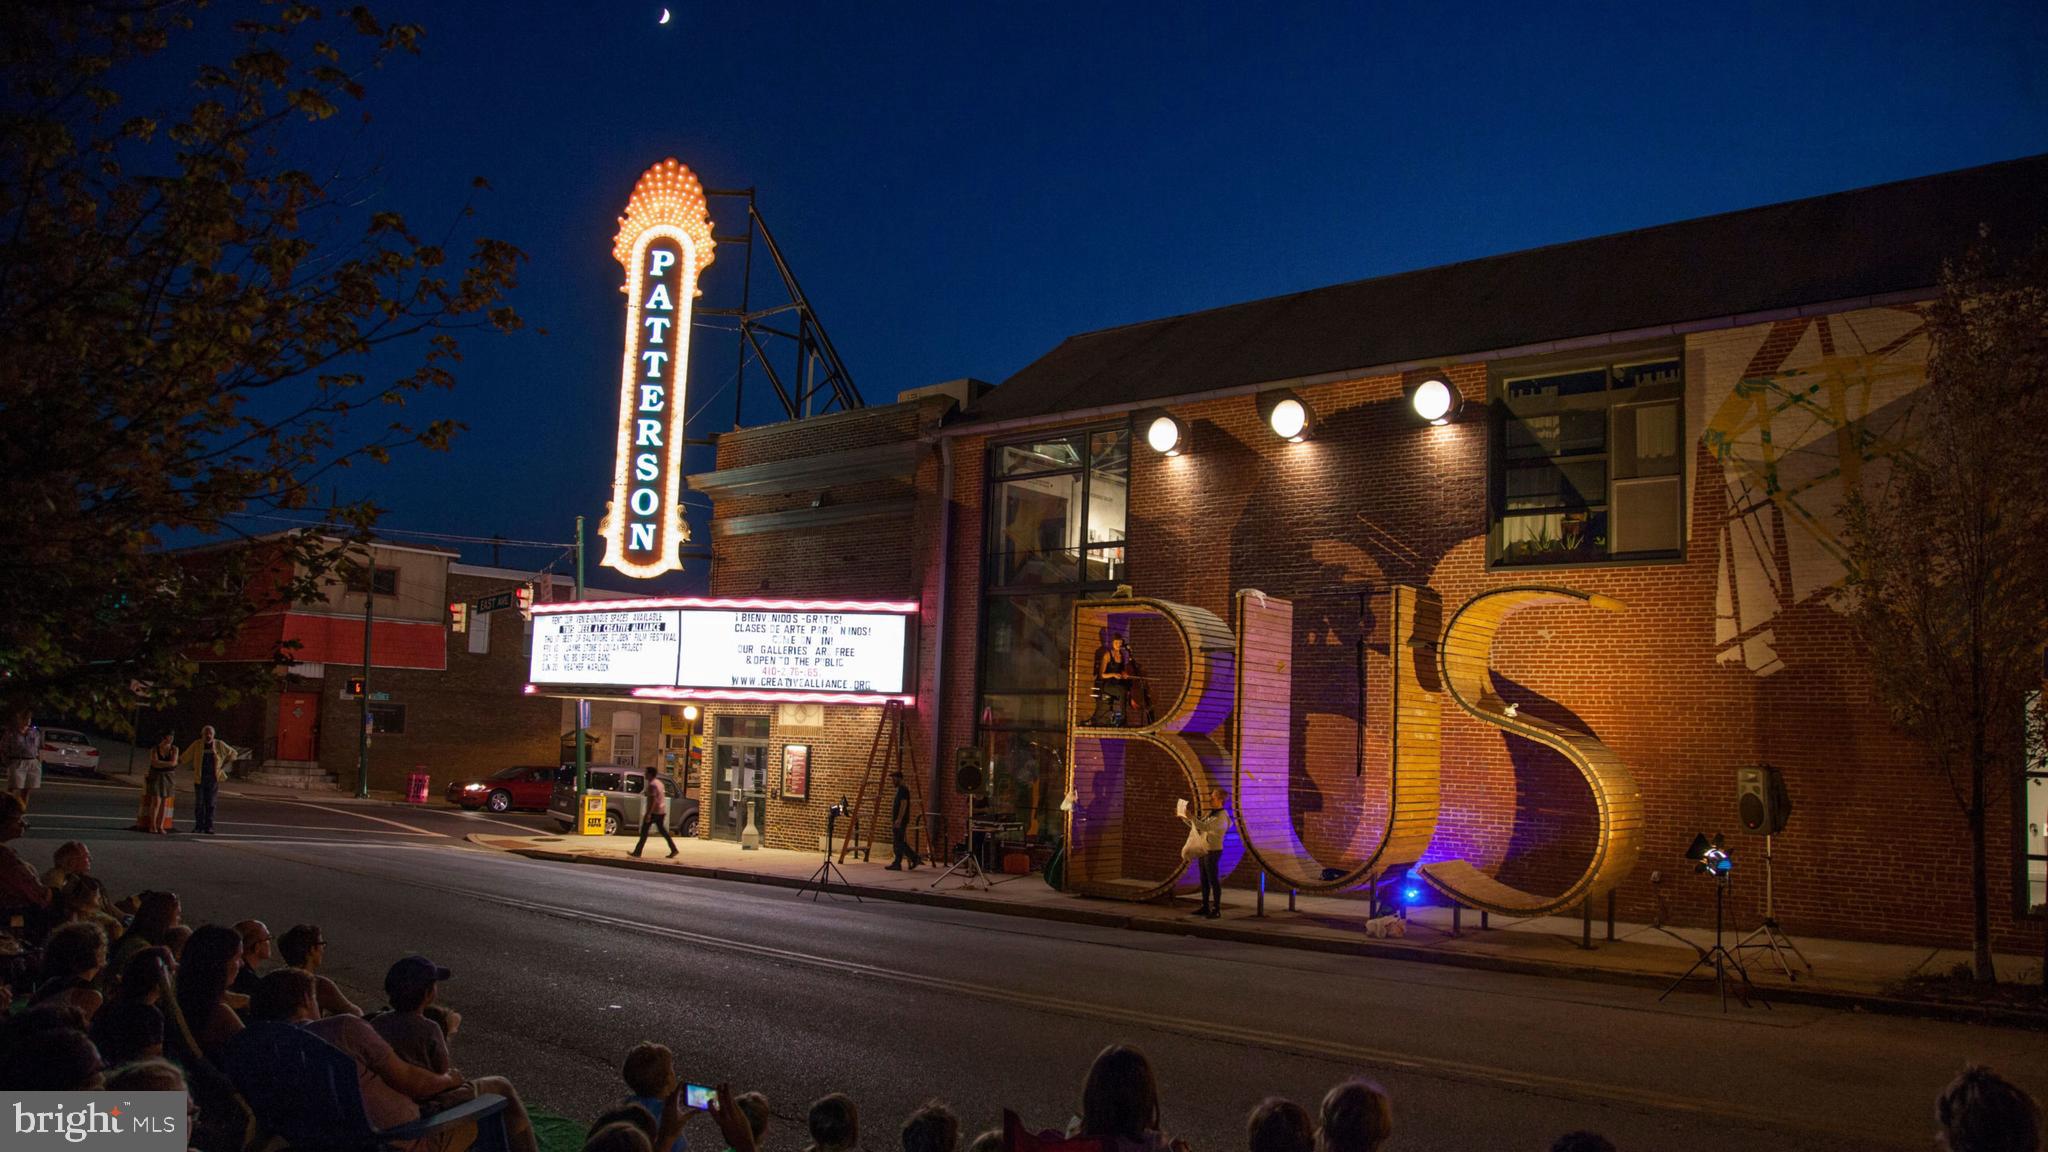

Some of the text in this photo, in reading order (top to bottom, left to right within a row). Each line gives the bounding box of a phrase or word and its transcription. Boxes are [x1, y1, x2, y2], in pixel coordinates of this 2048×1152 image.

[628, 250, 675, 550] PATTERSON
[480, 598, 496, 610] EAST
[632, 611, 663, 622] AVAILABLE
[734, 623, 766, 633] CLASES
[784, 624, 806, 634] ARTE
[649, 631, 677, 641] FESTIVAL
[772, 634, 796, 645] CME
[760, 645, 808, 656] GALLERIES
[835, 647, 856, 657] FREE
[795, 657, 809, 666] THE
[1064, 584, 1645, 917] BUS
